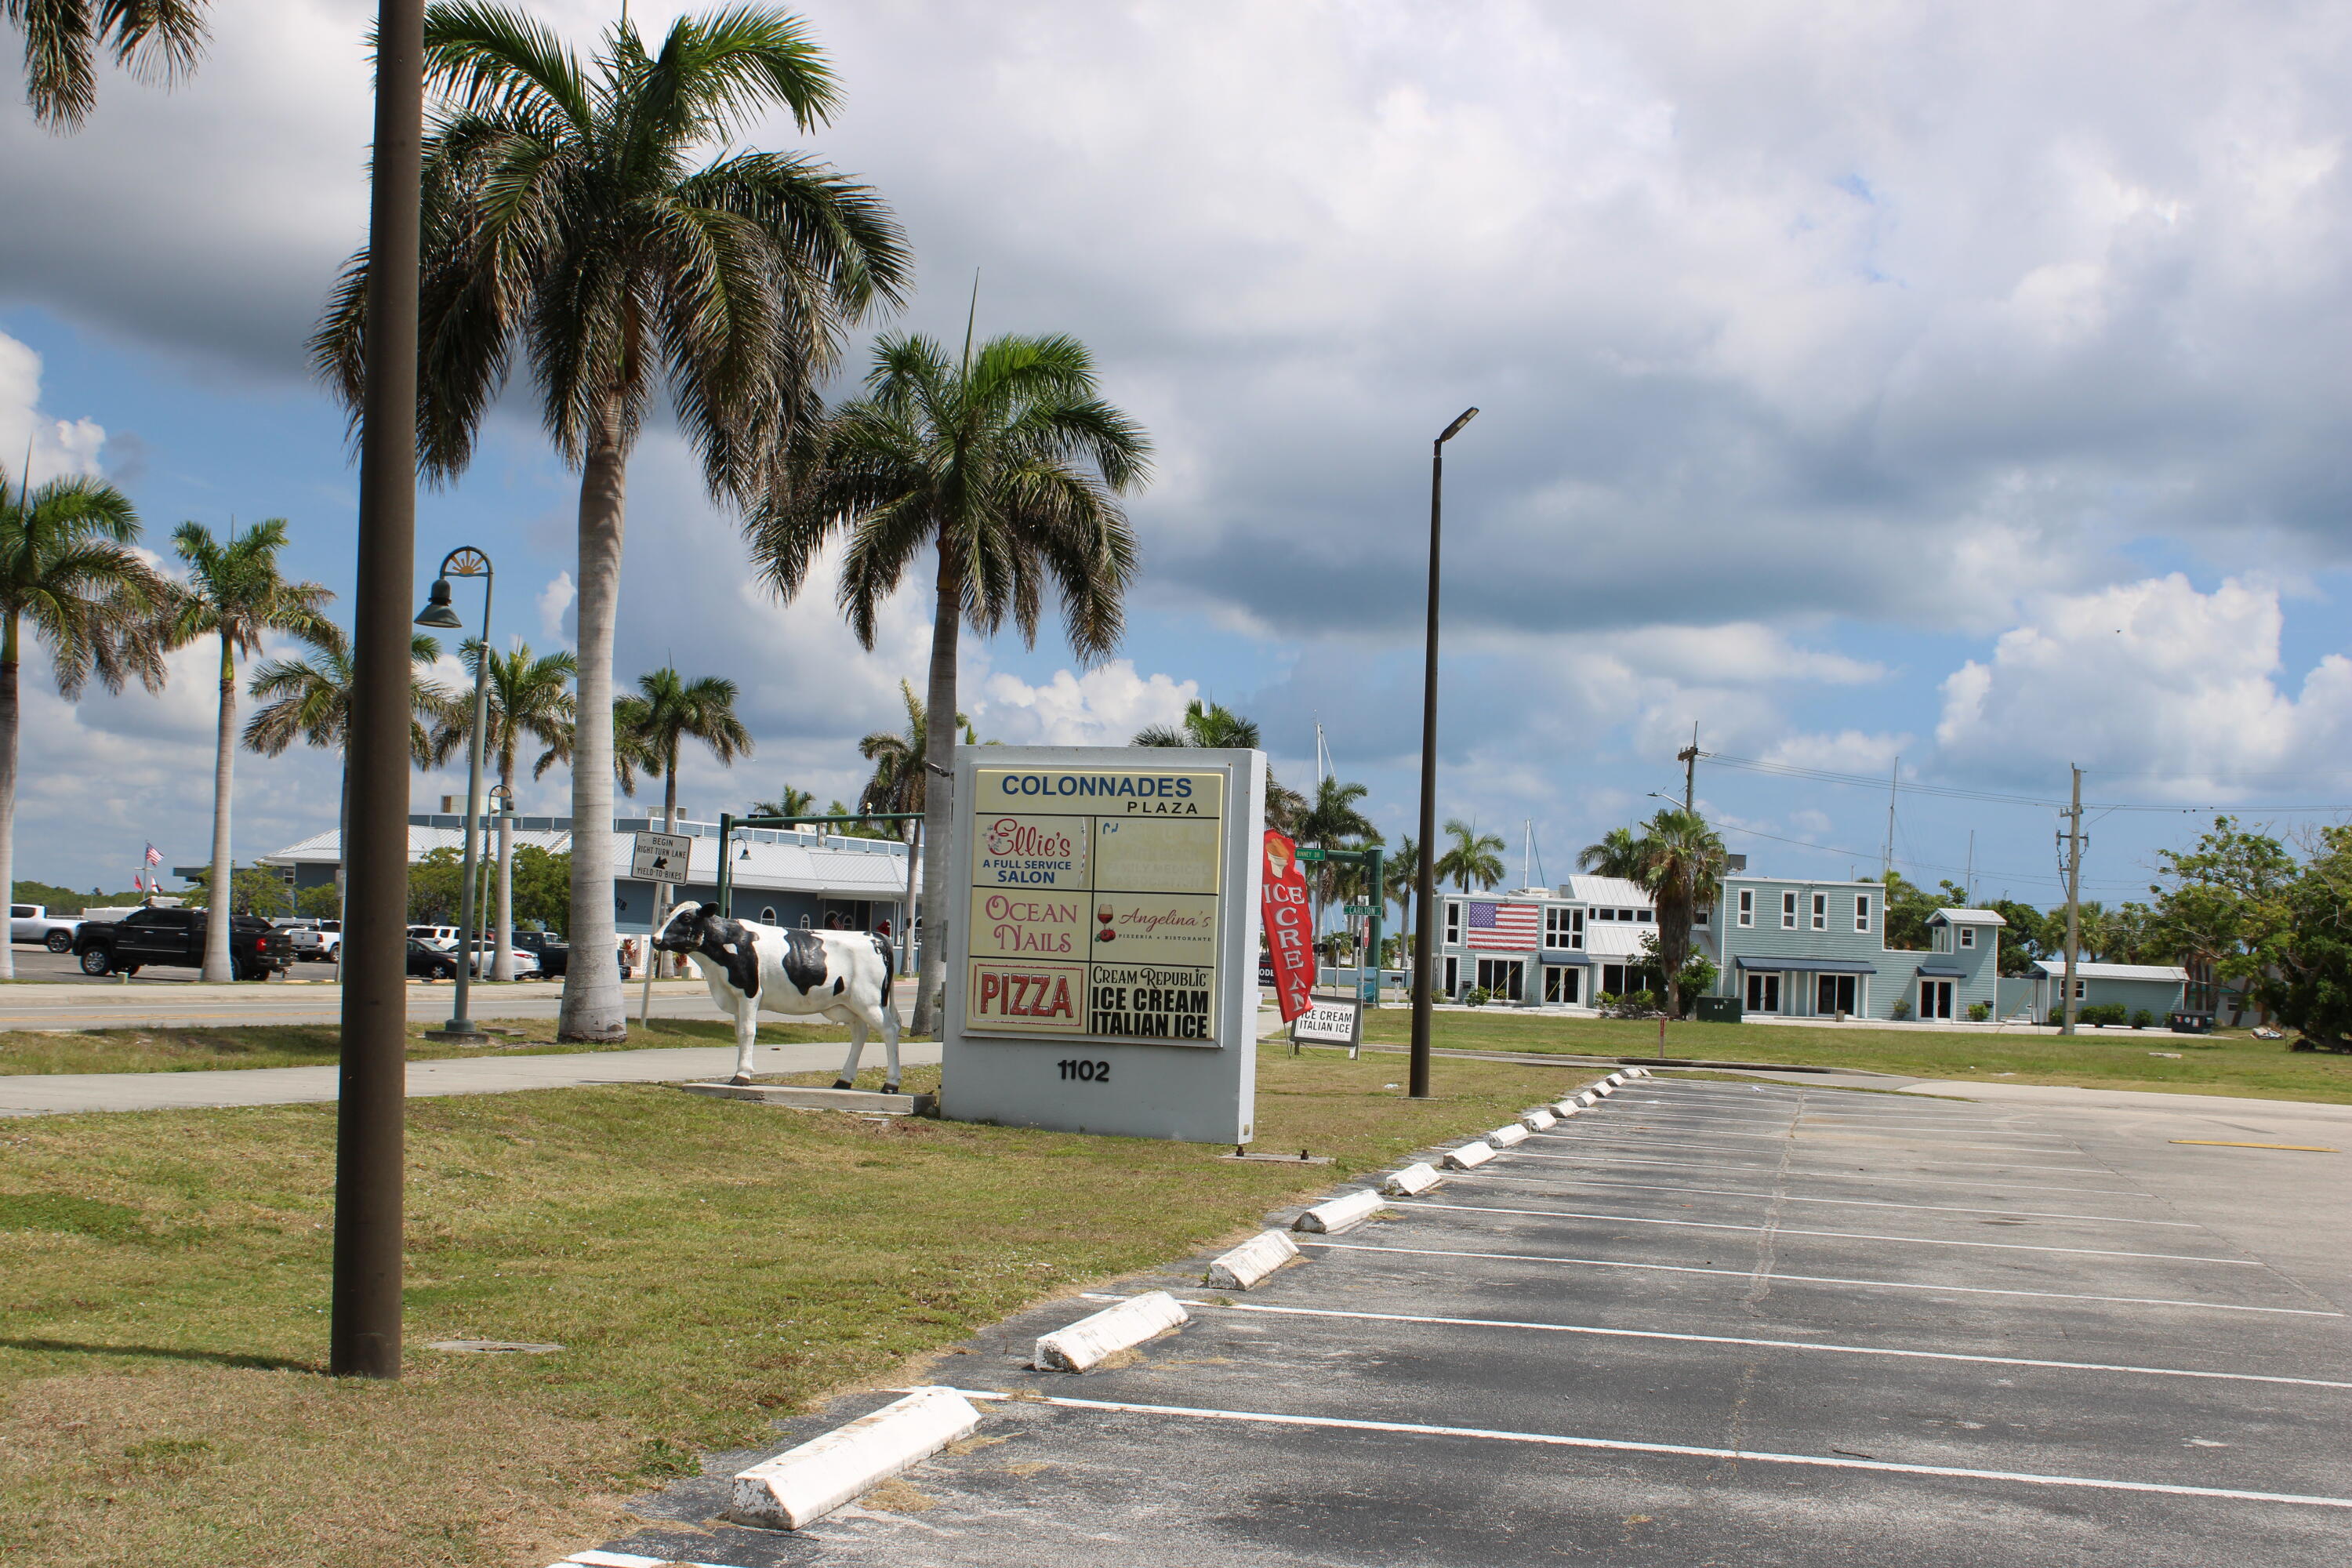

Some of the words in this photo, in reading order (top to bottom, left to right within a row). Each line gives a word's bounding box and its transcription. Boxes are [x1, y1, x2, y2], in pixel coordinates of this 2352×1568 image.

[1002, 775, 1192, 798] COLONNADES
[1127, 801, 1198, 815] PLAZA
[652, 837, 673, 847] BEGIN
[988, 818, 1070, 857] Ellie's
[637, 845, 653, 855] RIGHT
[655, 848, 670, 856] TURN
[672, 850, 687, 859] LANE
[637, 867, 653, 877] YIELD
[665, 871, 682, 880] BIKES
[982, 859, 990, 868] A
[994, 860, 1021, 869] FULL
[1025, 861, 1072, 870] SERVICE
[998, 870, 1054, 884] SALON
[1263, 884, 1305, 905] ICE
[985, 895, 1077, 924] OCEAN
[1349, 907, 1375, 916] CARLTON
[1119, 908, 1212, 932] Angelina's
[993, 924, 1072, 953] NAILS
[1093, 966, 1138, 984] CREAM
[980, 972, 1074, 1018] PIZZA
[1092, 987, 1127, 1010] ICE
[1134, 988, 1208, 1014] CREAM
[1092, 1011, 1169, 1036] ITALIAN
[1174, 1014, 1207, 1039] ICE
[1319, 1011, 1352, 1022] CREAM
[1300, 1020, 1333, 1032] ITALIAN
[1335, 1023, 1350, 1033] ICE
[1057, 1060, 1110, 1082] 1102
